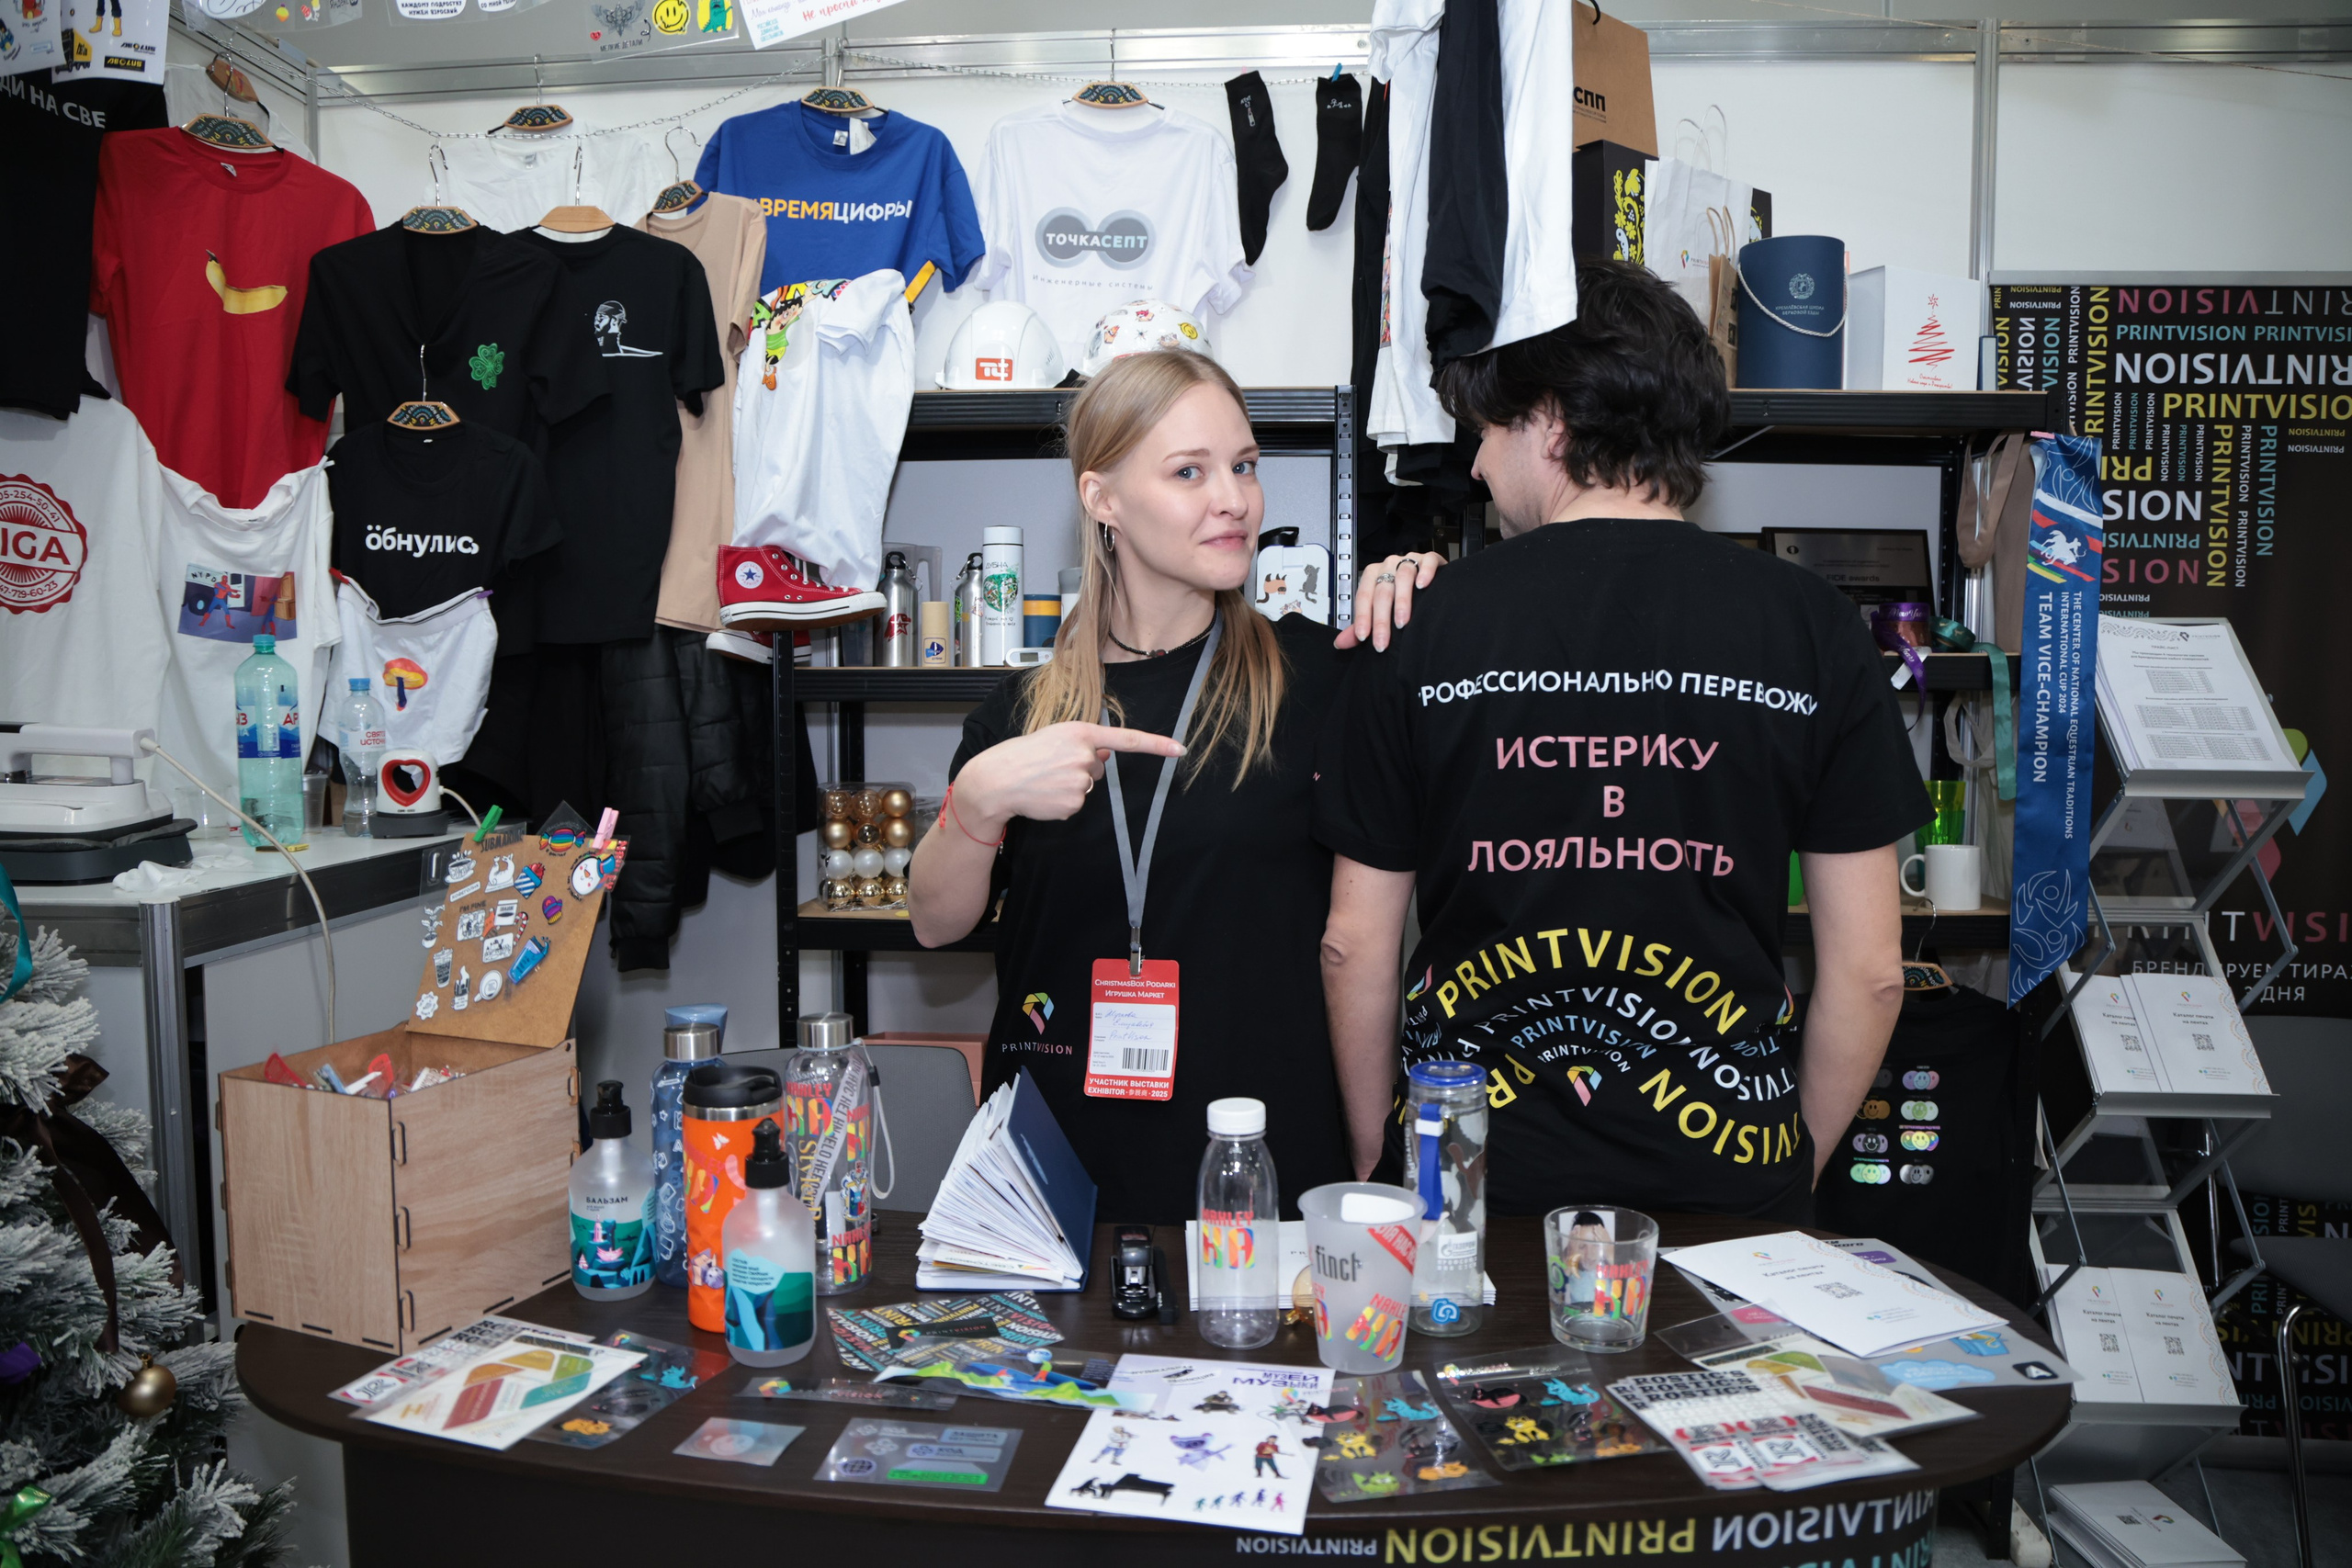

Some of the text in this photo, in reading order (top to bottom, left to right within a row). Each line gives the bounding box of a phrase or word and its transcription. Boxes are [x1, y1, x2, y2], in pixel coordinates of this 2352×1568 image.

[30, 85, 59, 116] НА
[1573, 86, 1606, 112] СПП
[755, 197, 912, 224] ВРЕМЯЦИФРЫ
[1046, 231, 1148, 248] ТОЧКАСЕПТ
[1032, 274, 1154, 291] Инженерные системы
[2068, 286, 2081, 364] PRINTVISION
[2116, 324, 2246, 342] PRINTVISION
[2041, 318, 2061, 391] VISION
[2085, 287, 2110, 438] RINTVISION
[2112, 392, 2122, 450] PRINTVISION
[2129, 392, 2139, 450] PRINTVISION
[2145, 392, 2155, 450] PRINTVISION
[2289, 428, 2346, 437] PRINTVISION
[2160, 424, 2170, 482] PRINTVISION
[2177, 424, 2188, 482] PRINTVISION
[2195, 424, 2205, 482] PRINTVISION
[2288, 445, 2345, 454] PRINTVISION
[2206, 424, 2233, 587] PRINTVISION
[2234, 425, 2252, 588] PRINTVISION PRINTVISION
[2256, 425, 2278, 557] PRINTVISION
[190, 571, 217, 583] NYPD
[2058, 592, 2069, 714] INTERNATIONAL CUP 2024
[1419, 669, 1673, 705] РОФЕССИОНАЛЬНО
[2032, 592, 2053, 783] TEAM VICE-CHAMPION
[2064, 591, 2082, 839] THE CENTER OF NATIONAL EQUESTRIAN TRADITIONS
[1496, 734, 1719, 770] ИСТЕРИКУ
[1603, 785, 1625, 818] В
[1468, 837, 1735, 876] ЛОЯЛЬНОТЬ
[1146, 980, 1176, 988] PODARKI
[1436, 928, 1747, 1035] PRINTVISION
[2133, 961, 2352, 980] БРЕНДРУЕ ТИРА
[1001, 1042, 1073, 1055] PRINTVISION
[1088, 1087, 1125, 1096] EXHIBITOR
[1089, 1077, 1170, 1089] УЧАСТНИК ВЫСТАВКИ
[585, 1196, 628, 1204] БАЛЬЗАМ
[1232, 1376, 1318, 1390] МУЗЫКИ
[1262, 1371, 1319, 1382] МУЗЕЙ
[1634, 1370, 1746, 1385] ROSTIC'S
[1639, 1378, 1753, 1393] ROSTIC'S
[1645, 1385, 1761, 1402] ROSTIC'S
[1236, 1537, 1377, 1556] PRINTVISION
[1385, 1518, 1696, 1563] PRINTVISION
